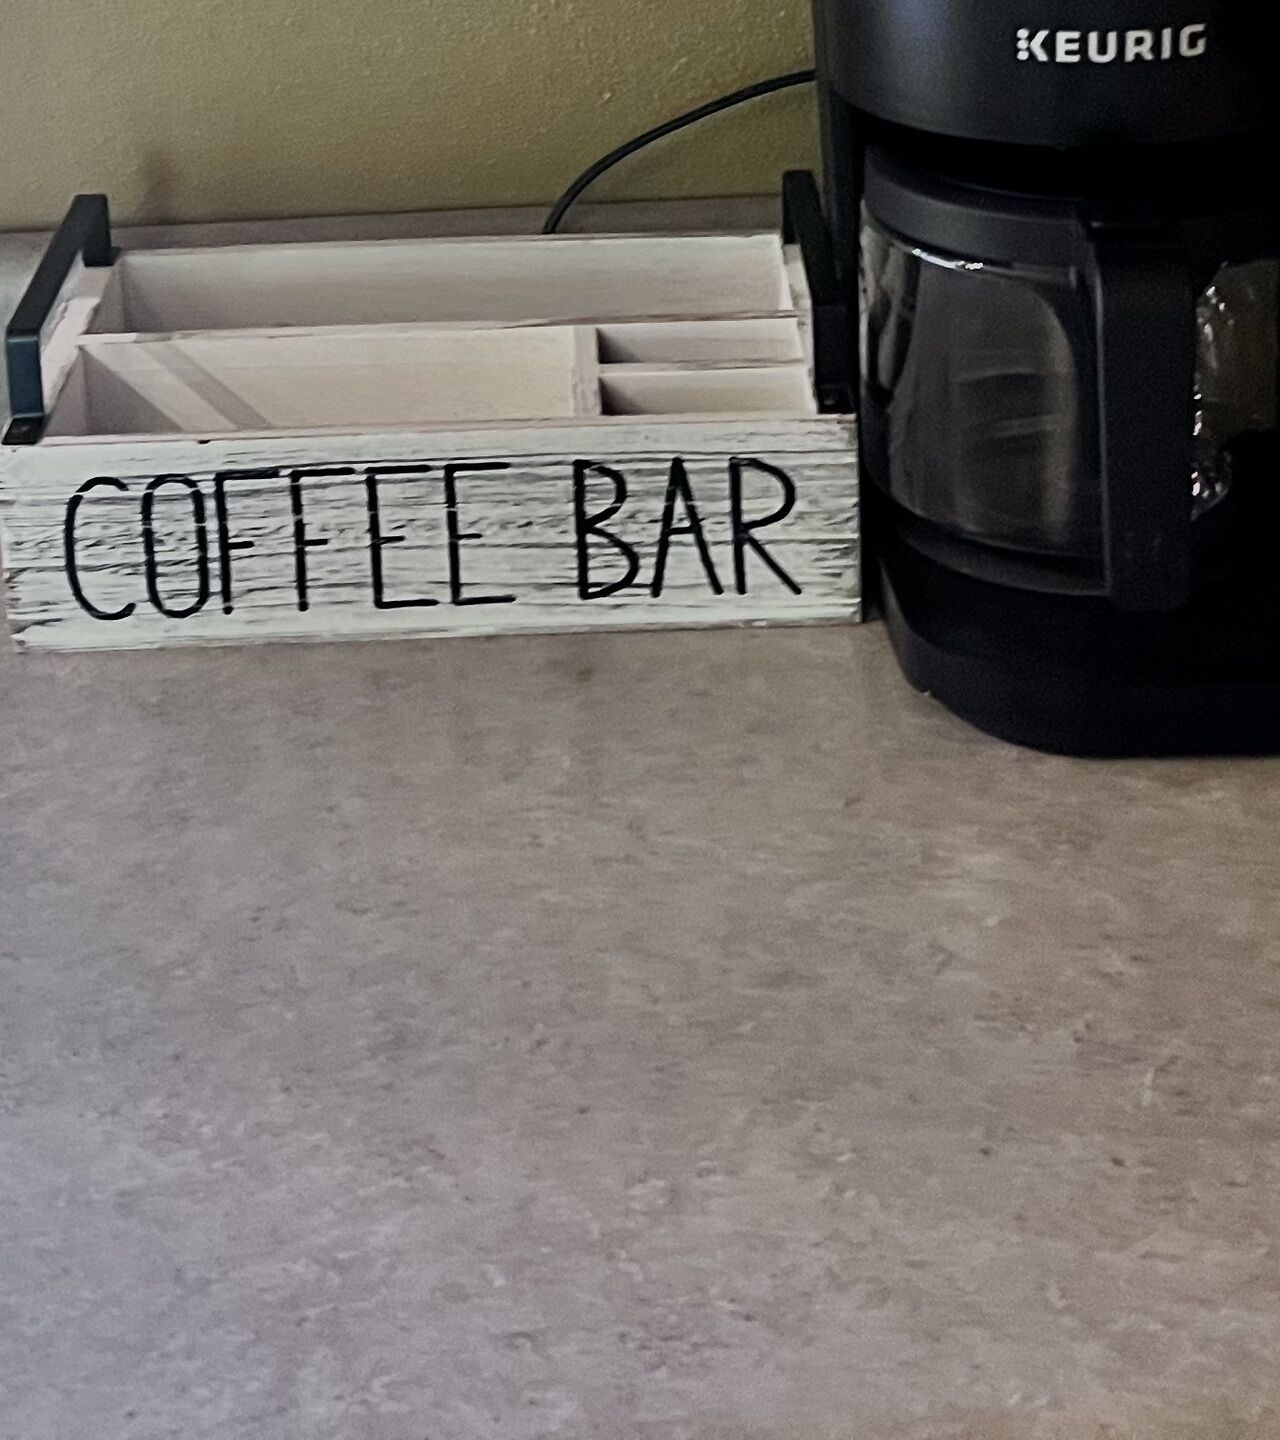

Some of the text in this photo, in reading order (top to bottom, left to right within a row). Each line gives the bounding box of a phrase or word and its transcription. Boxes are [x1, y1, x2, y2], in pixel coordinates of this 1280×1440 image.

[1016, 23, 1207, 63] KEURIG
[63, 456, 802, 621] COFFEE BAR
